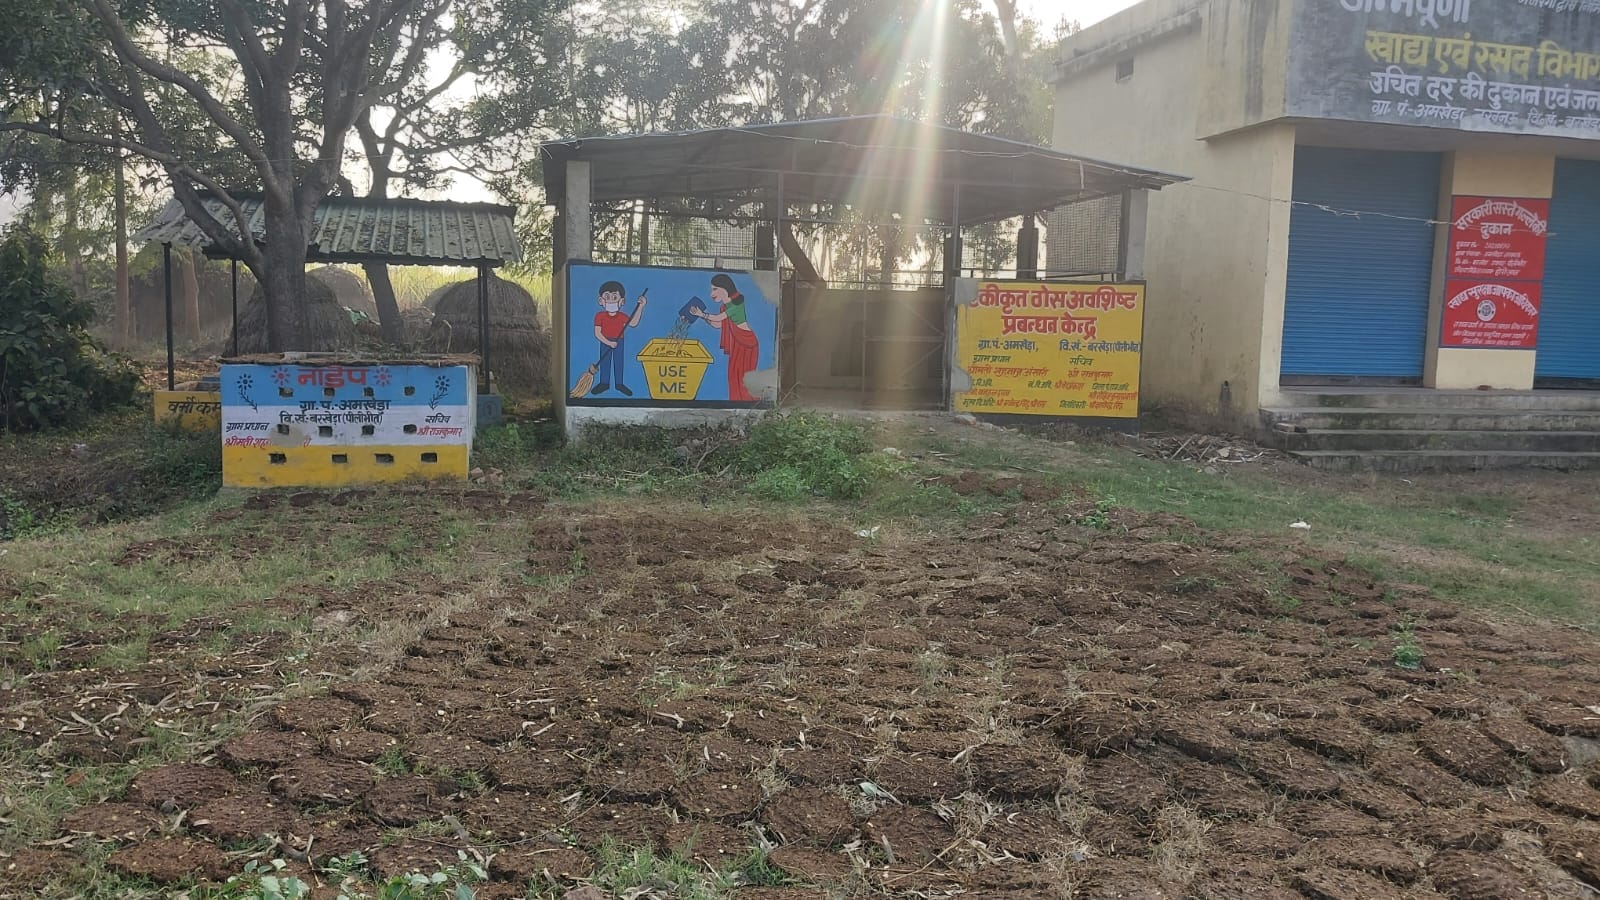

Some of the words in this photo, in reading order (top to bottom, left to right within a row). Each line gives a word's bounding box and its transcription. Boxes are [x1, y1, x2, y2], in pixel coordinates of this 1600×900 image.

[1364, 30, 1432, 66] खाद्य
[1435, 32, 1474, 73] एवं
[1475, 42, 1534, 80] रसद
[1369, 65, 1422, 96] उचित
[1426, 76, 1457, 101] दर
[1460, 72, 1487, 100] की
[1488, 81, 1541, 110] दुकान
[1454, 199, 1493, 231] सरकारी
[1480, 222, 1513, 240] दुकान
[968, 283, 1029, 314] कीकृत
[1031, 285, 1068, 309] ठोस
[1066, 286, 1138, 312] अवशिष्ट
[1000, 315, 1059, 335] प्रबन्धन
[1060, 311, 1097, 340] केन्द्र
[658, 365, 688, 378] USE
[1069, 355, 1094, 366] सचिव
[660, 381, 687, 394] ME
[425, 412, 451, 423] सचिव
